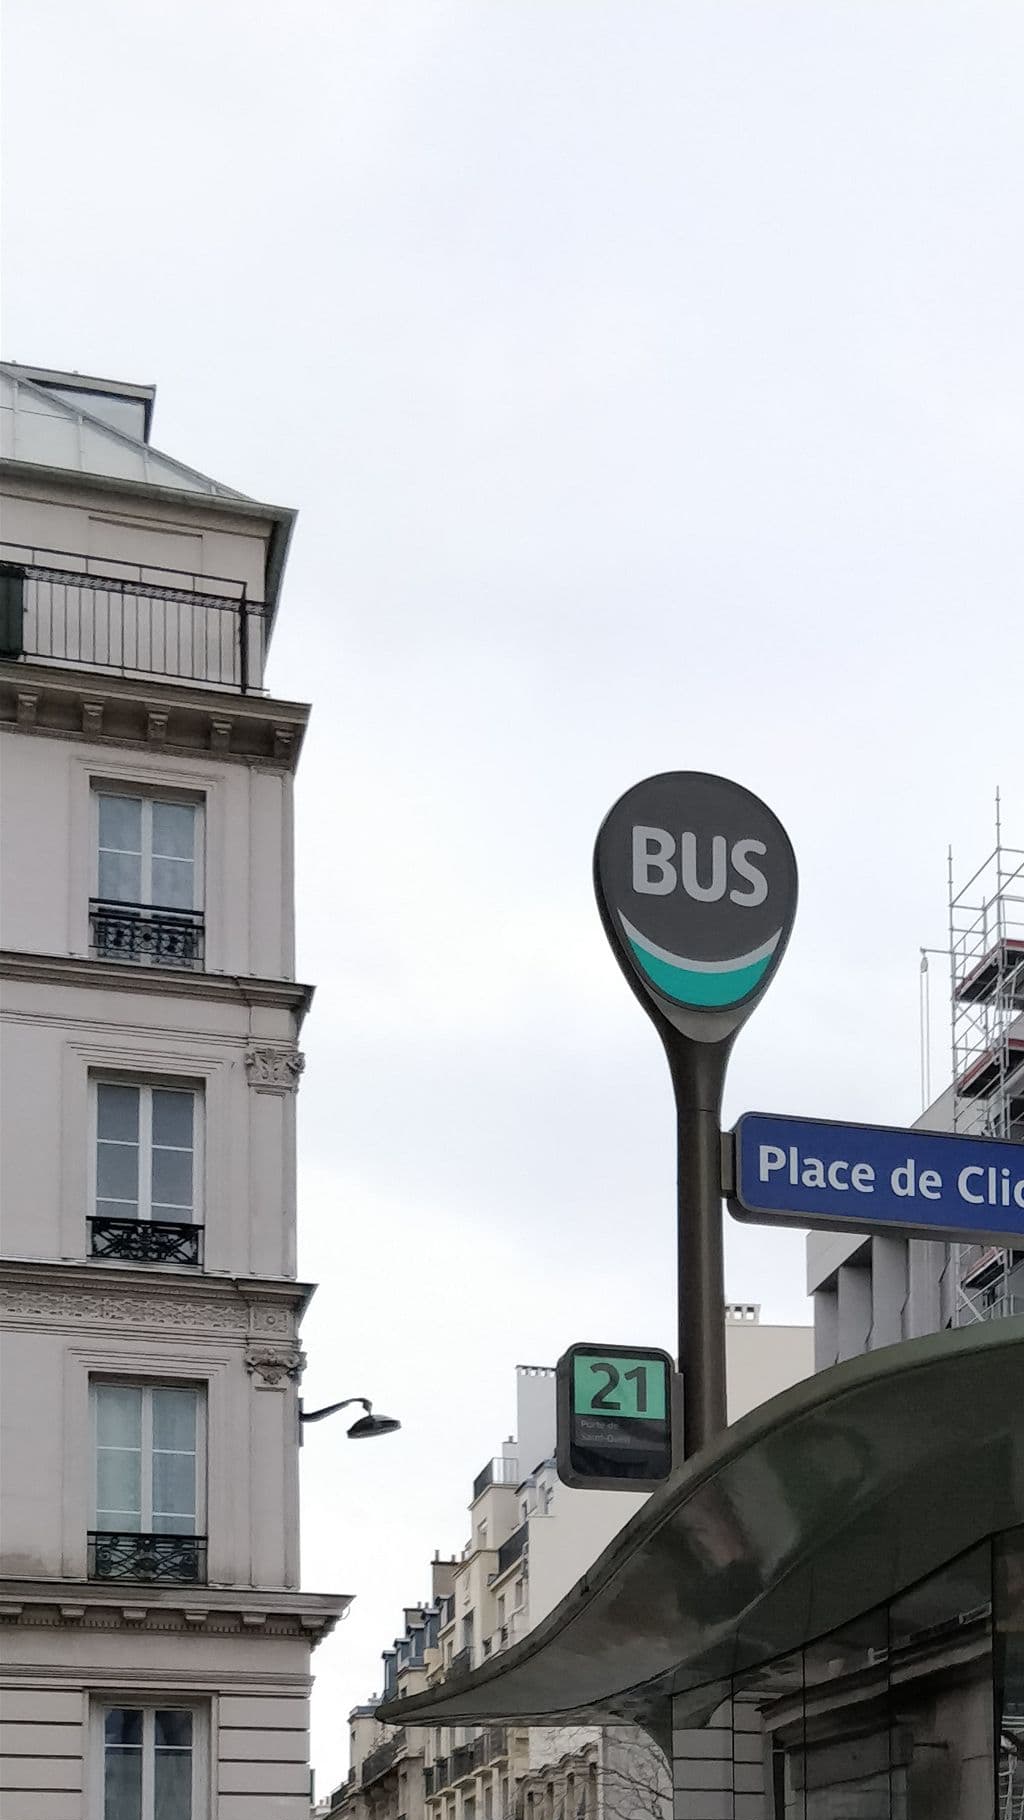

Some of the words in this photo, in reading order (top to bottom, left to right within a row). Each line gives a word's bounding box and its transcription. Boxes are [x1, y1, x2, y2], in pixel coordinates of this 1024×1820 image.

[632, 825, 768, 908] BUS
[758, 1144, 876, 1193] Place
[890, 1158, 943, 1200] de
[590, 1362, 648, 1413] 21
